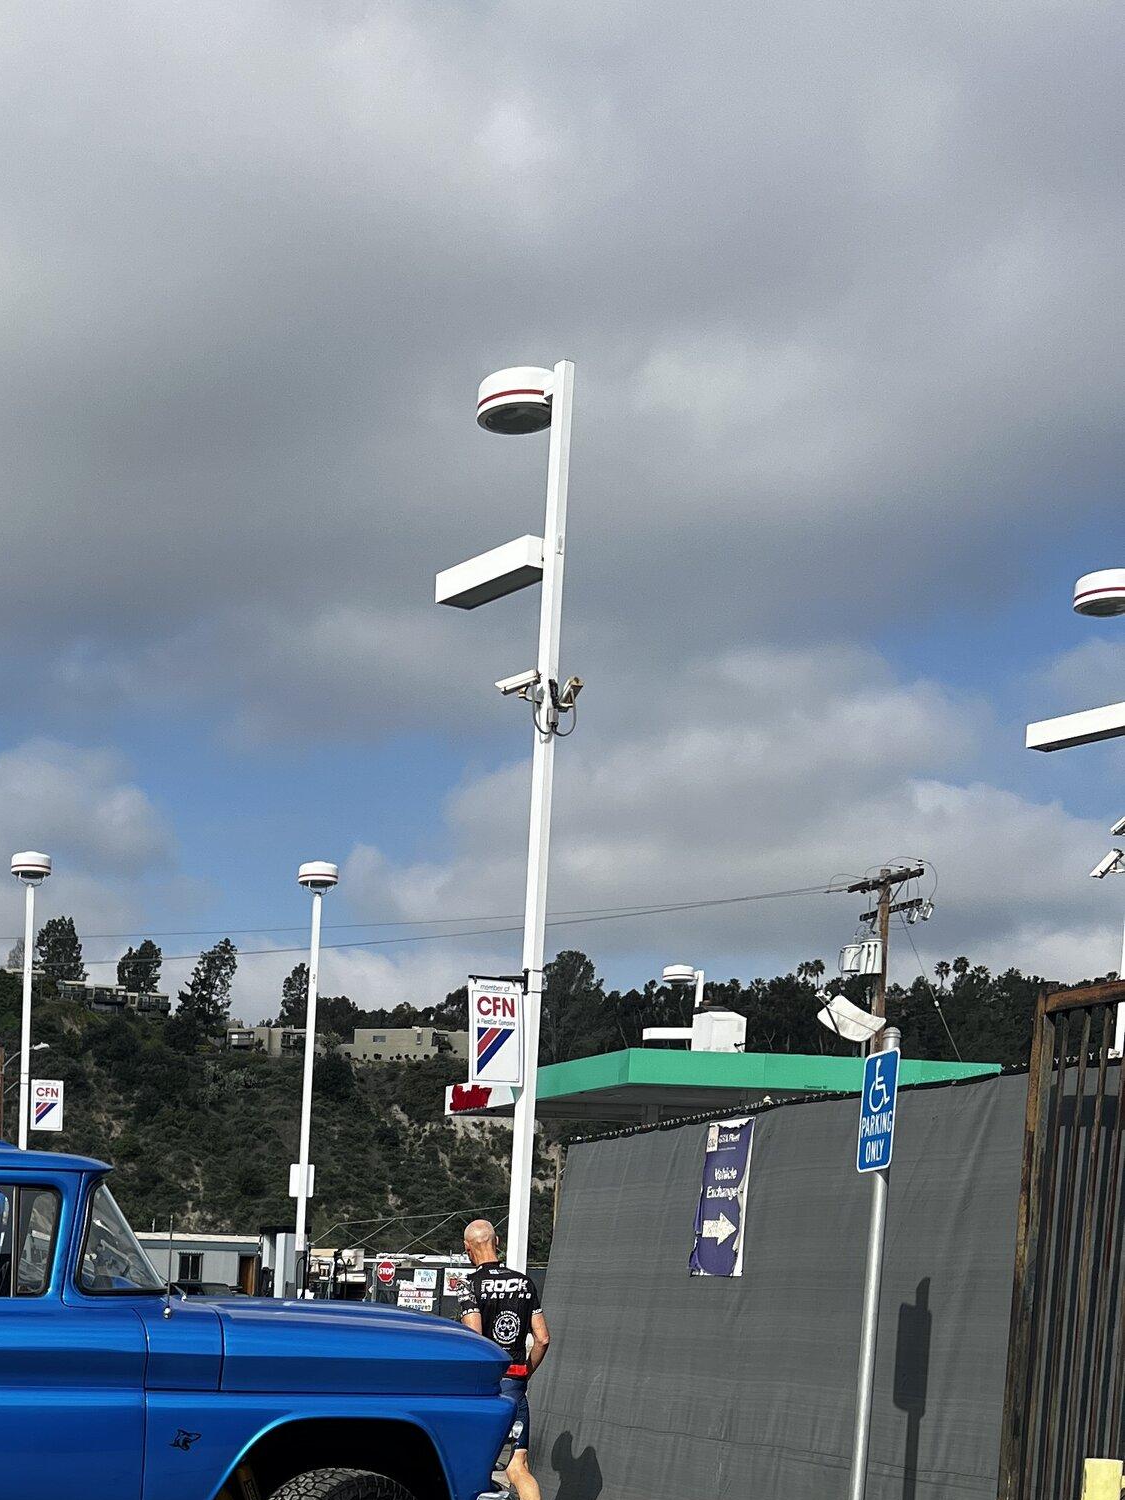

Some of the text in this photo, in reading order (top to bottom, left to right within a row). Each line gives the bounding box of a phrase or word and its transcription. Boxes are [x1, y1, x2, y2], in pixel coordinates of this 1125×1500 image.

[480, 984, 503, 992] member
[477, 996, 515, 1017] CFN
[36, 1087, 59, 1098] CFN
[861, 1110, 893, 1138] PARKING
[866, 1139, 884, 1163] ONLY
[715, 1167, 737, 1180] Vehicle
[378, 1267, 395, 1275] STOP
[480, 1278, 528, 1292] ROCK
